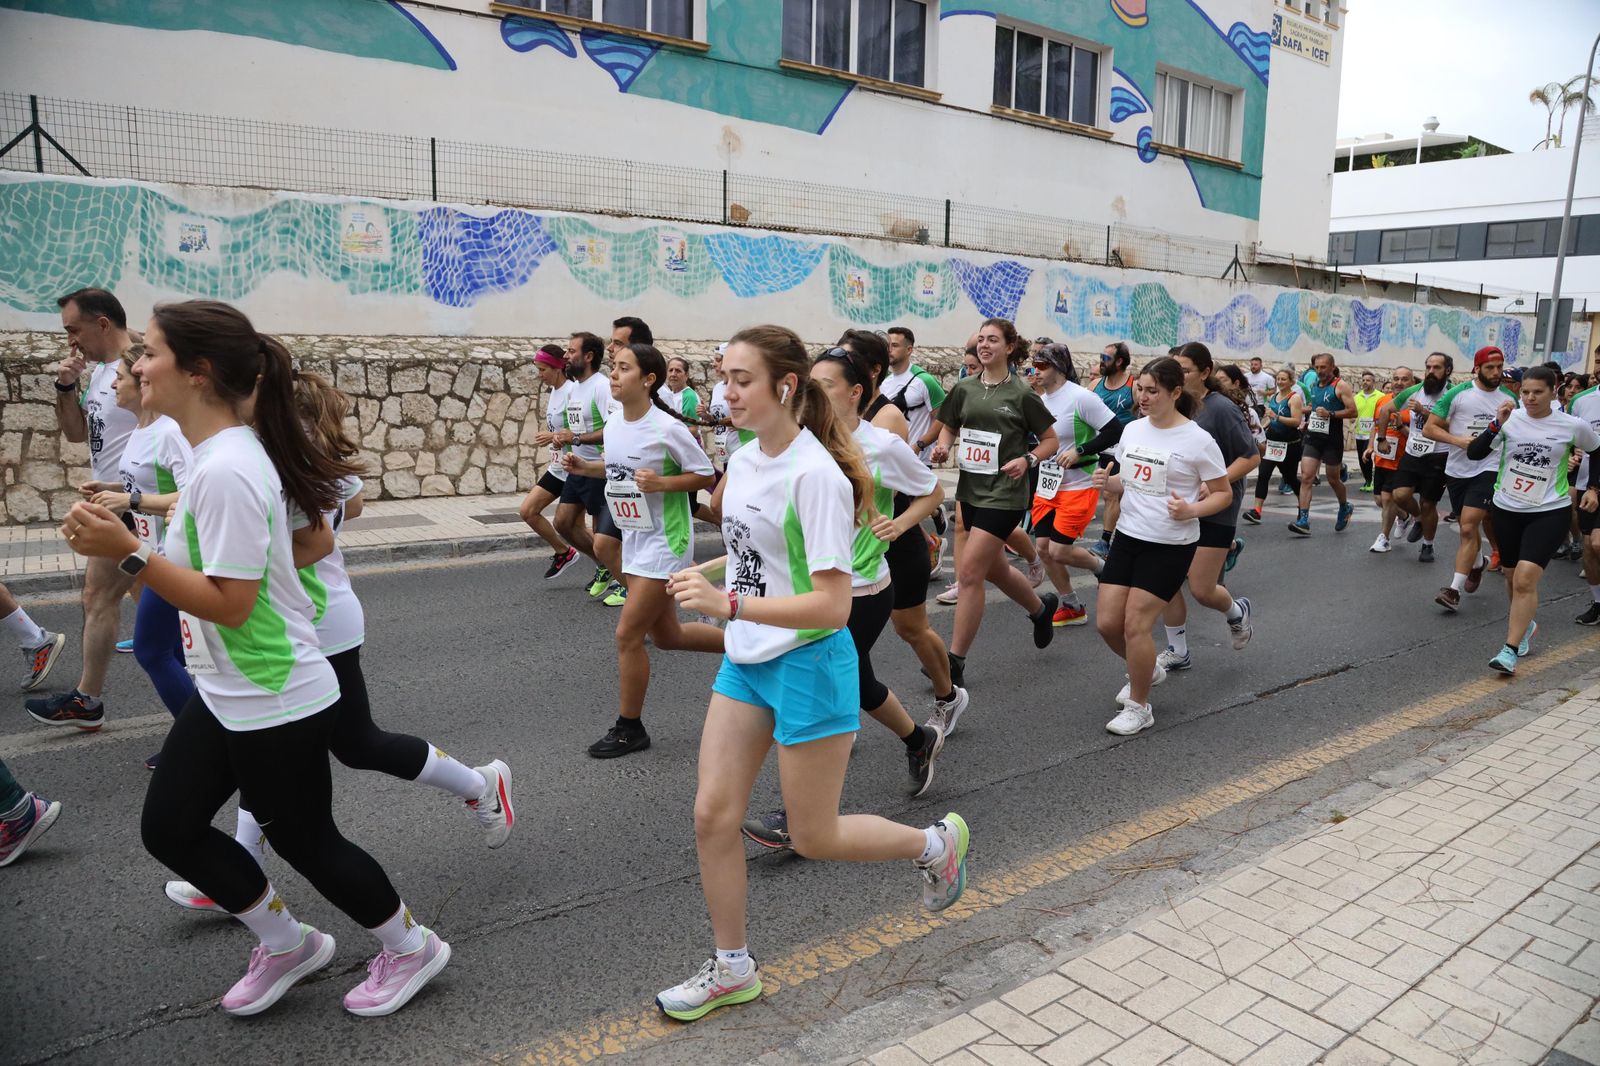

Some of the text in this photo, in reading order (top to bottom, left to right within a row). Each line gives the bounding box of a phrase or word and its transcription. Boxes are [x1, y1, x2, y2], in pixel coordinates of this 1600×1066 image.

[1282, 35, 1303, 53] SAFA
[1311, 46, 1329, 62] ICET
[965, 446, 991, 464] 104
[1269, 448, 1283, 457] 309
[1412, 442, 1430, 453] 887
[1133, 463, 1152, 482] 79
[1041, 477, 1058, 491] 880
[1513, 478, 1535, 493] 57
[613, 501, 642, 518] 101
